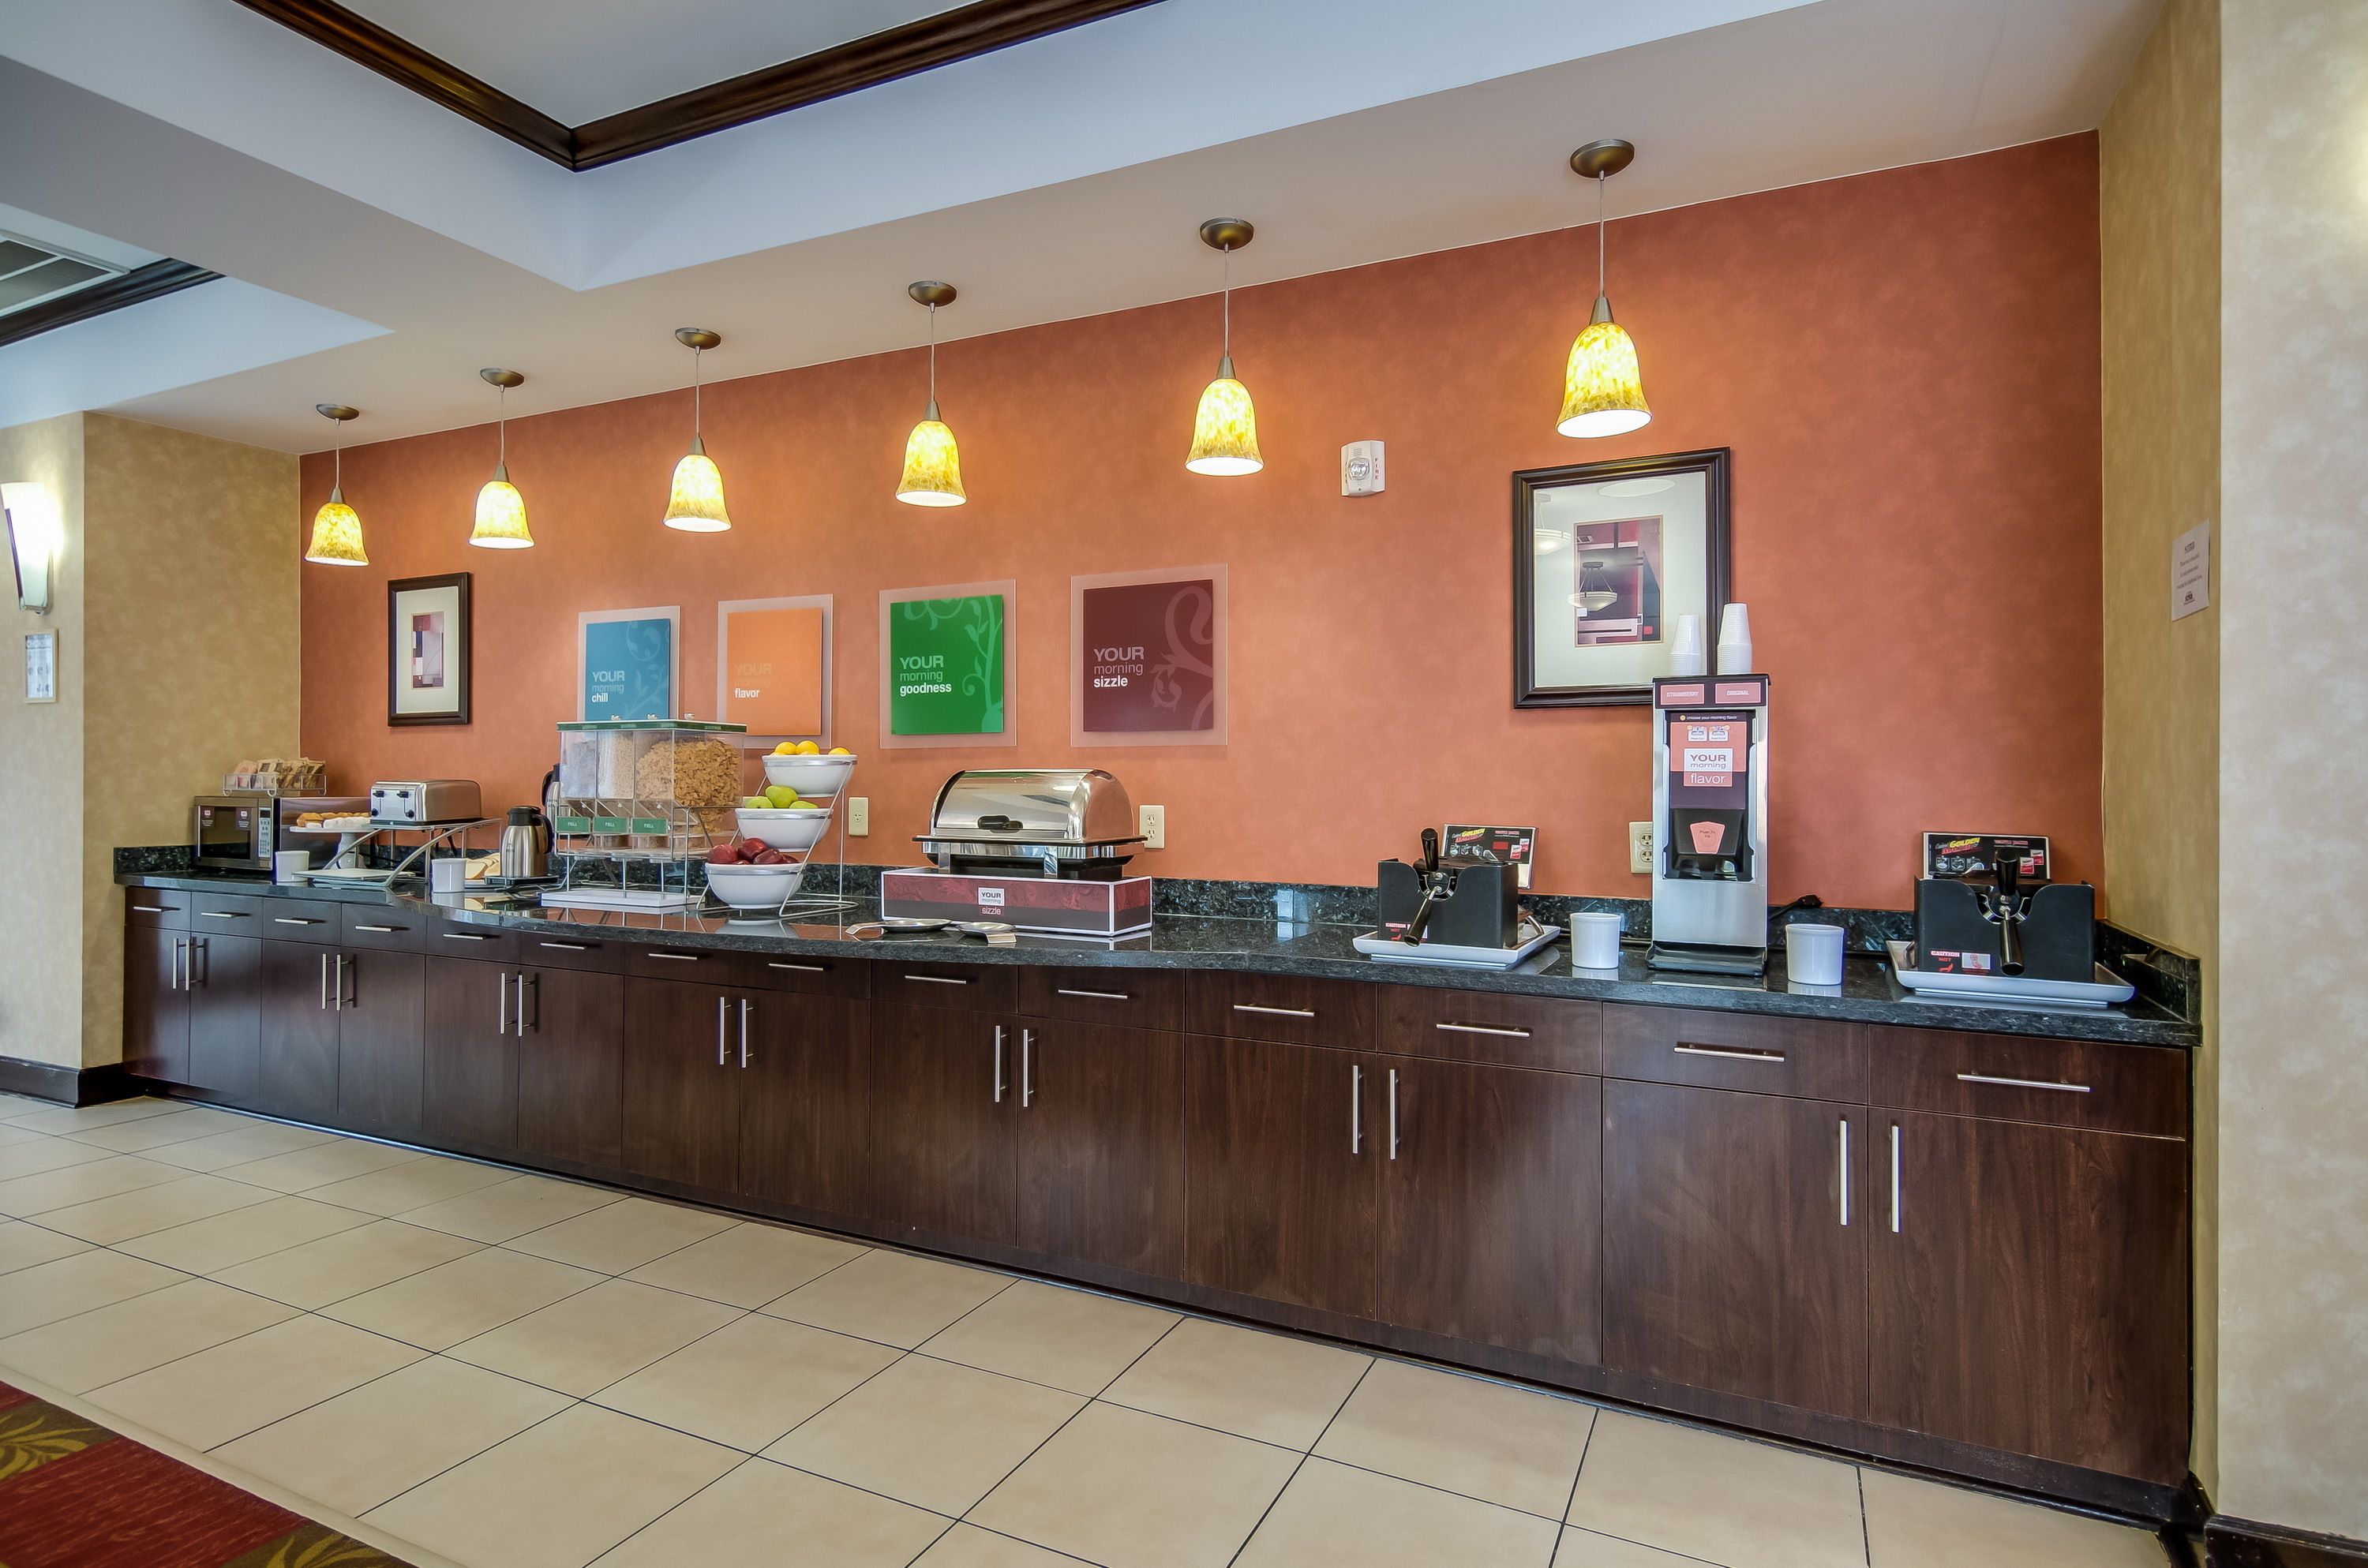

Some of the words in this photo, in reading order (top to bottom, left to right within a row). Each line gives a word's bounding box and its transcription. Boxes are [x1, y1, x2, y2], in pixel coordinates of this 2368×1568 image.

[1093, 646, 1145, 661] YOUR
[899, 655, 944, 669] YOUR
[735, 663, 772, 676] YOUR
[1094, 662, 1144, 676] morning
[592, 670, 625, 683] YOUR
[900, 669, 943, 683] morning
[1093, 675, 1129, 688] sizzle
[592, 682, 624, 694] morning
[735, 687, 760, 698] flavor
[900, 682, 952, 697] goodness
[591, 692, 609, 703] chill
[1690, 773, 1726, 784] flavor
[1950, 837, 1980, 848] GOLDEN
[981, 906, 1002, 915] sizzle
